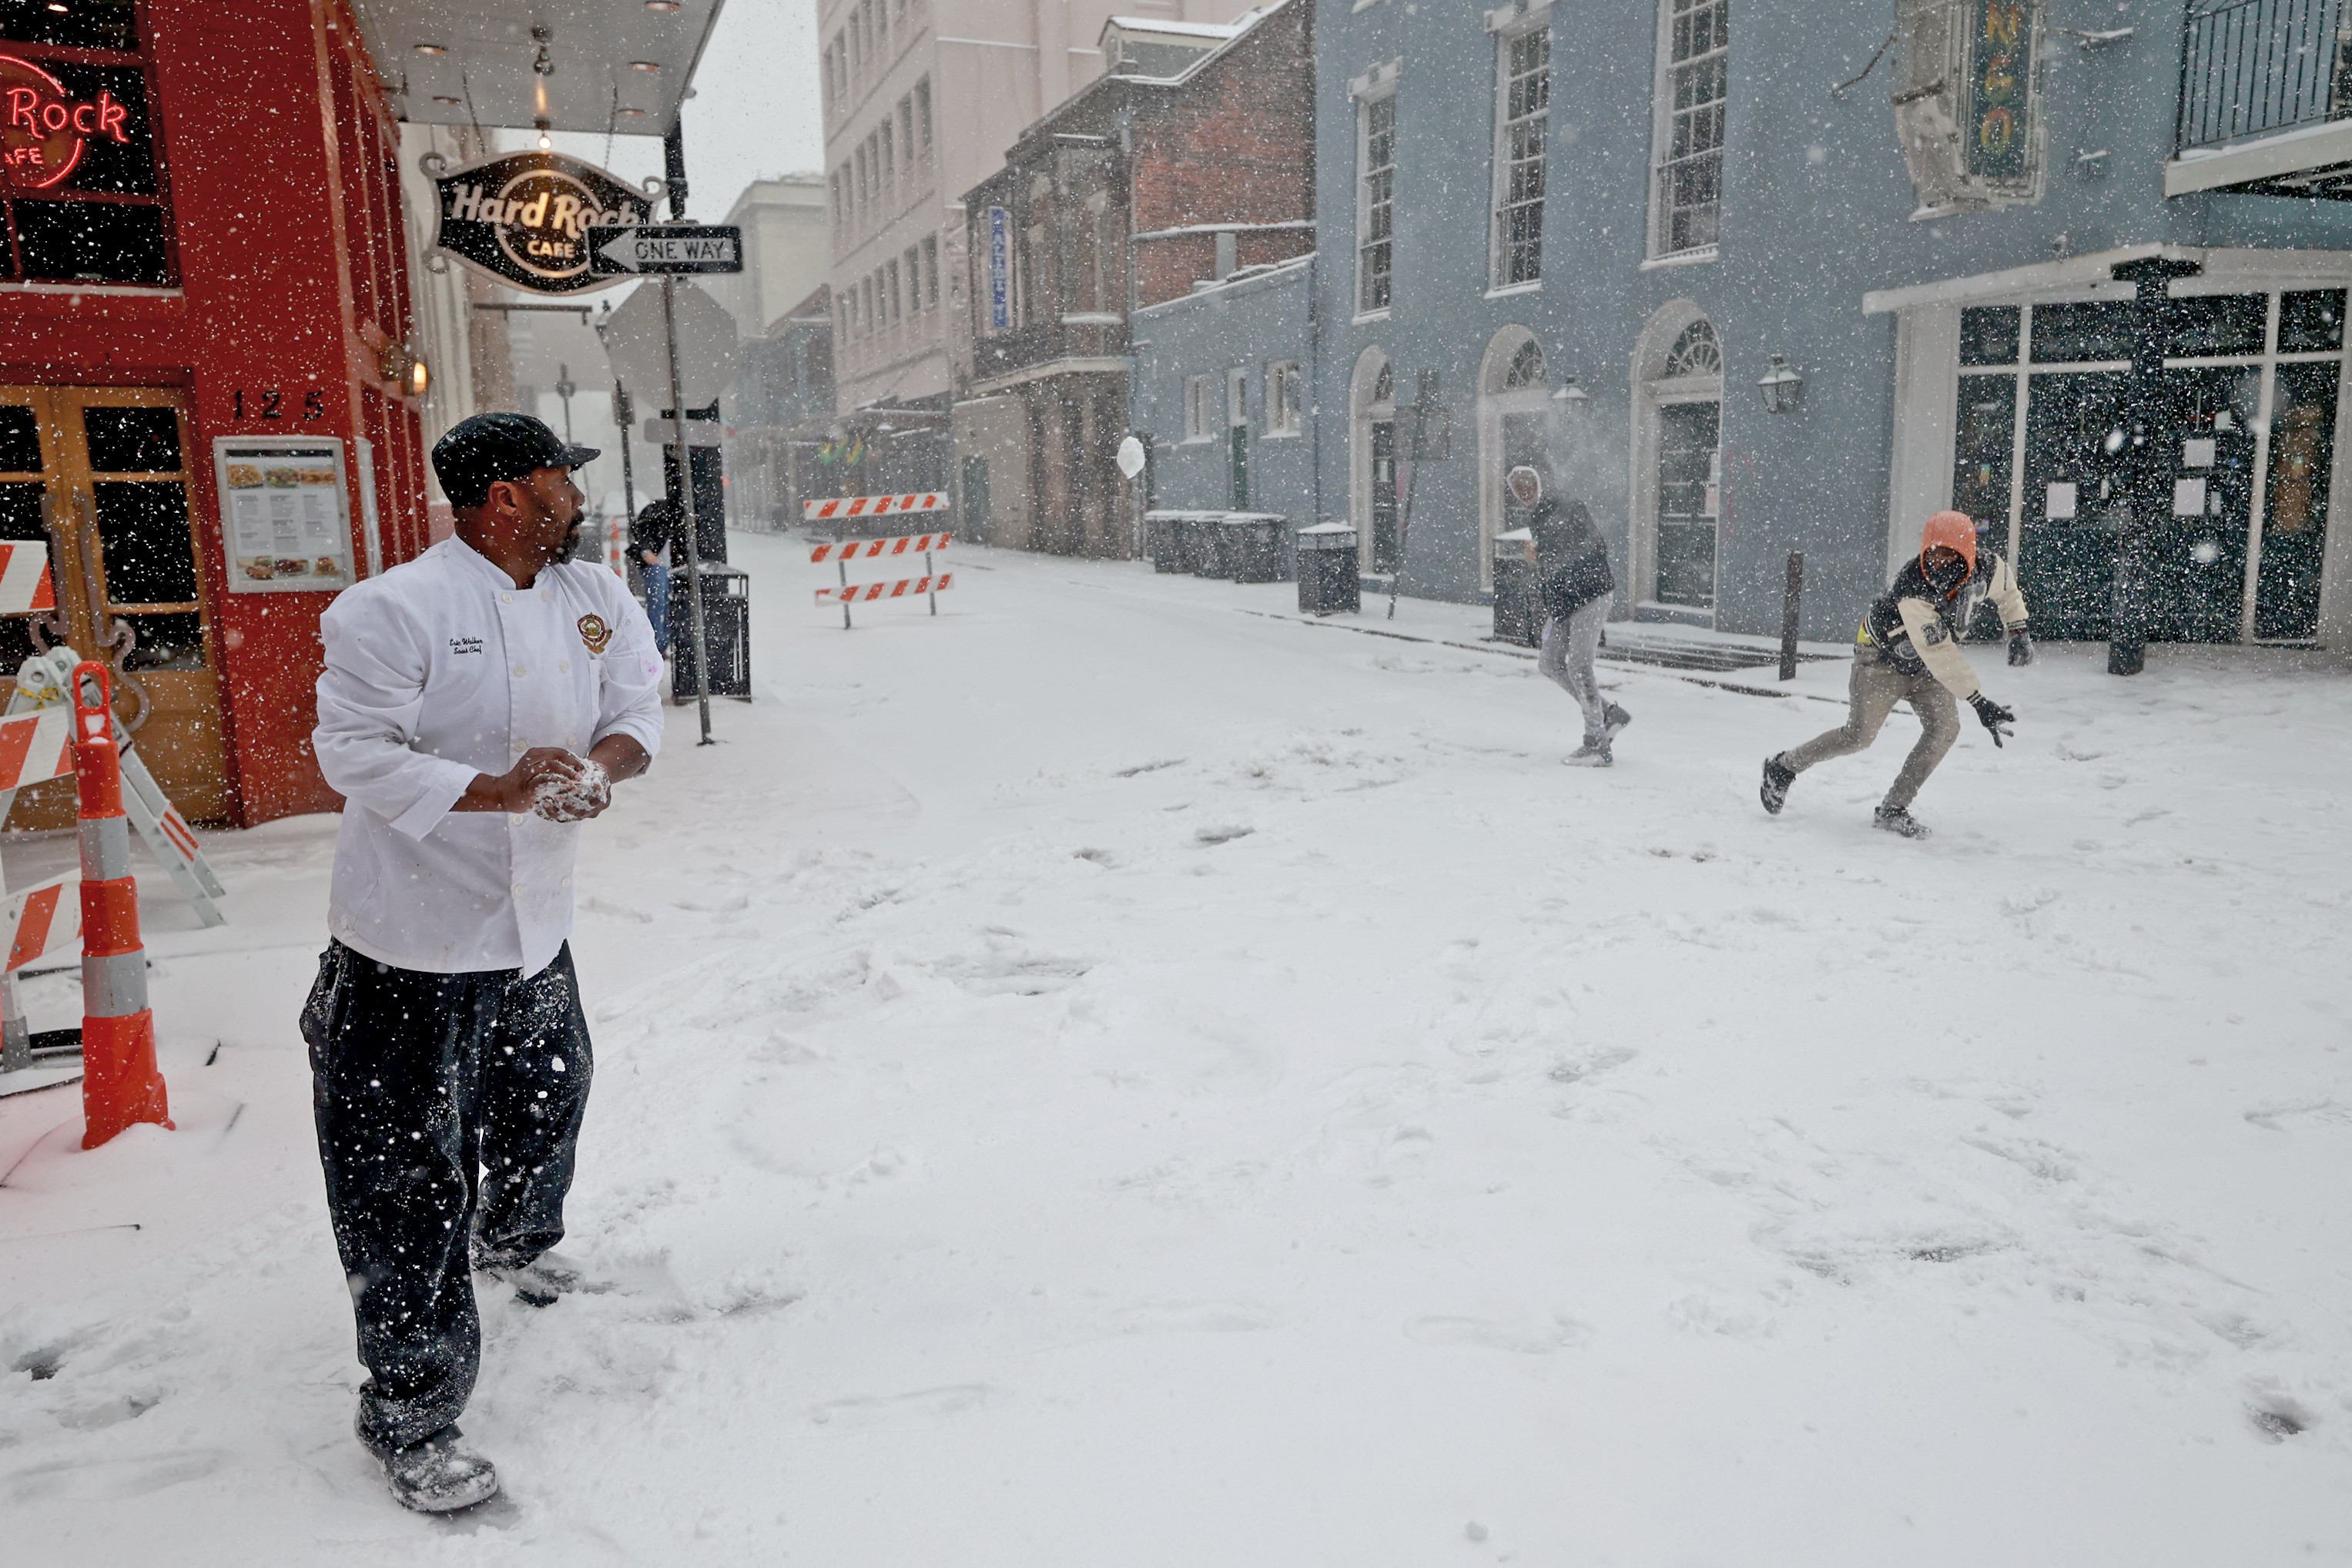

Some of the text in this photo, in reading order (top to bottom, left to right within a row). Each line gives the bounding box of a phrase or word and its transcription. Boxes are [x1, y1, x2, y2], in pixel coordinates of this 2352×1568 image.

[6, 87, 129, 143] Rock
[451, 183, 641, 240] Hard Rock
[527, 240, 575, 259] CAFE
[635, 241, 725, 260] ONE WAY
[235, 389, 323, 420] 125
[462, 637, 483, 645] Walker
[469, 645, 481, 655] Chef
